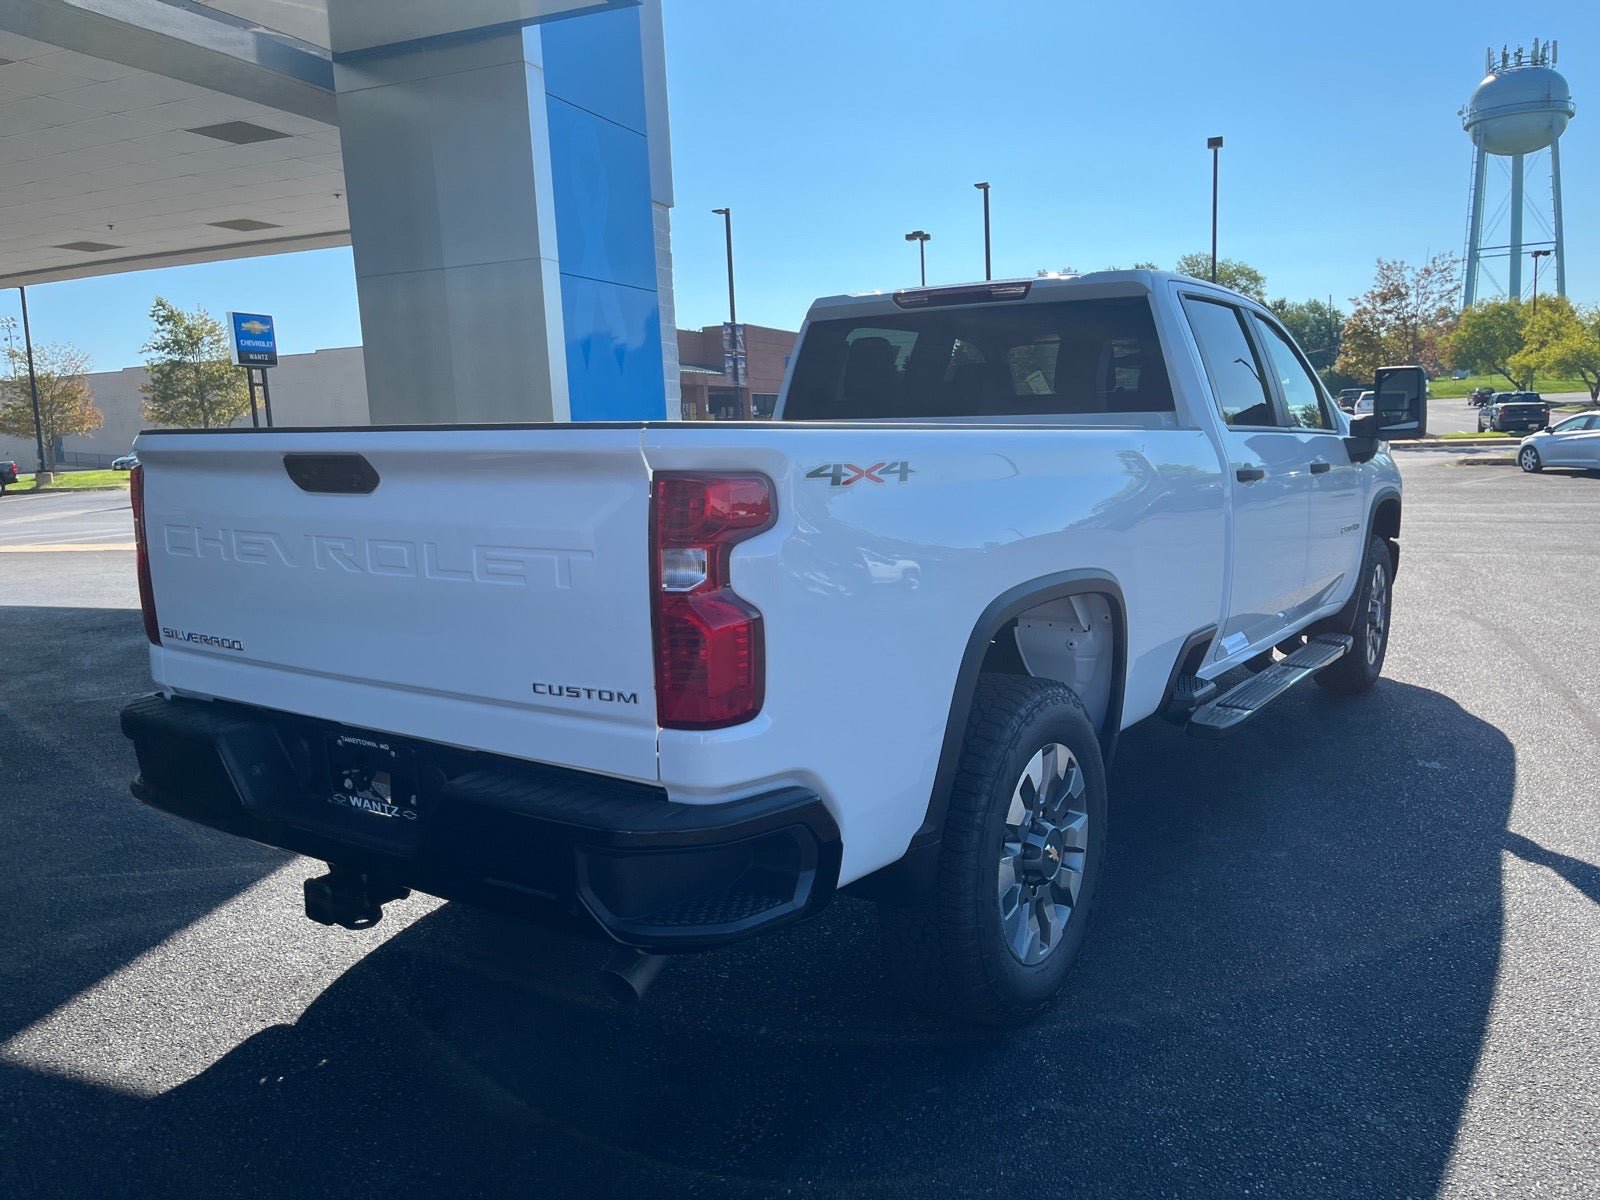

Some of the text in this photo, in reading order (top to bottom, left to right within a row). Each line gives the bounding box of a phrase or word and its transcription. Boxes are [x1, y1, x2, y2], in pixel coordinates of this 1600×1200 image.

[240, 339, 273, 347] CHEVROLET
[249, 353, 269, 361] WANTZ
[163, 523, 594, 590] CHEVROLET
[162, 627, 245, 651] SILVERADO
[532, 682, 639, 705] CUSTOM
[348, 795, 401, 818] WANTZ
